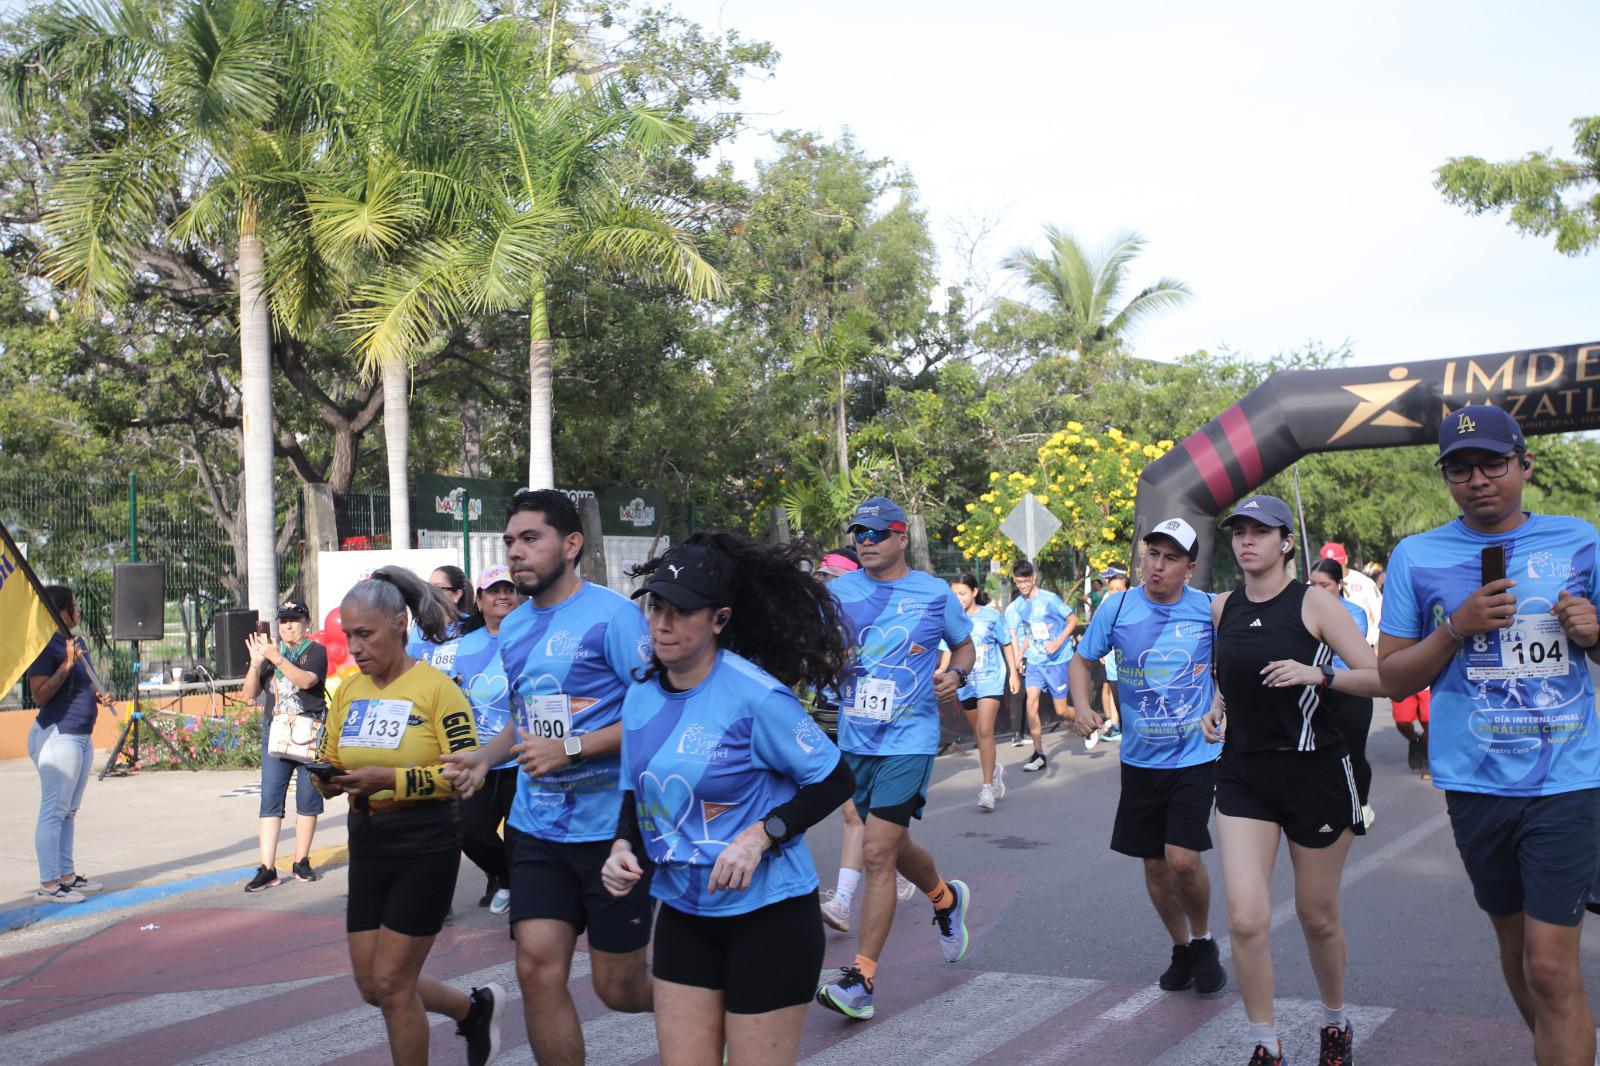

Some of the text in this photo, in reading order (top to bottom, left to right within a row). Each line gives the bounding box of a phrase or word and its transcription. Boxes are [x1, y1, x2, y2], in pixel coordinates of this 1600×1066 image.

[1457, 413, 1476, 434] LA
[1473, 633, 1488, 653] 8
[1512, 640, 1563, 665] 104
[860, 695, 888, 711] 131
[347, 710, 359, 726] 8
[367, 719, 401, 738] 133
[533, 719, 564, 738] 090
